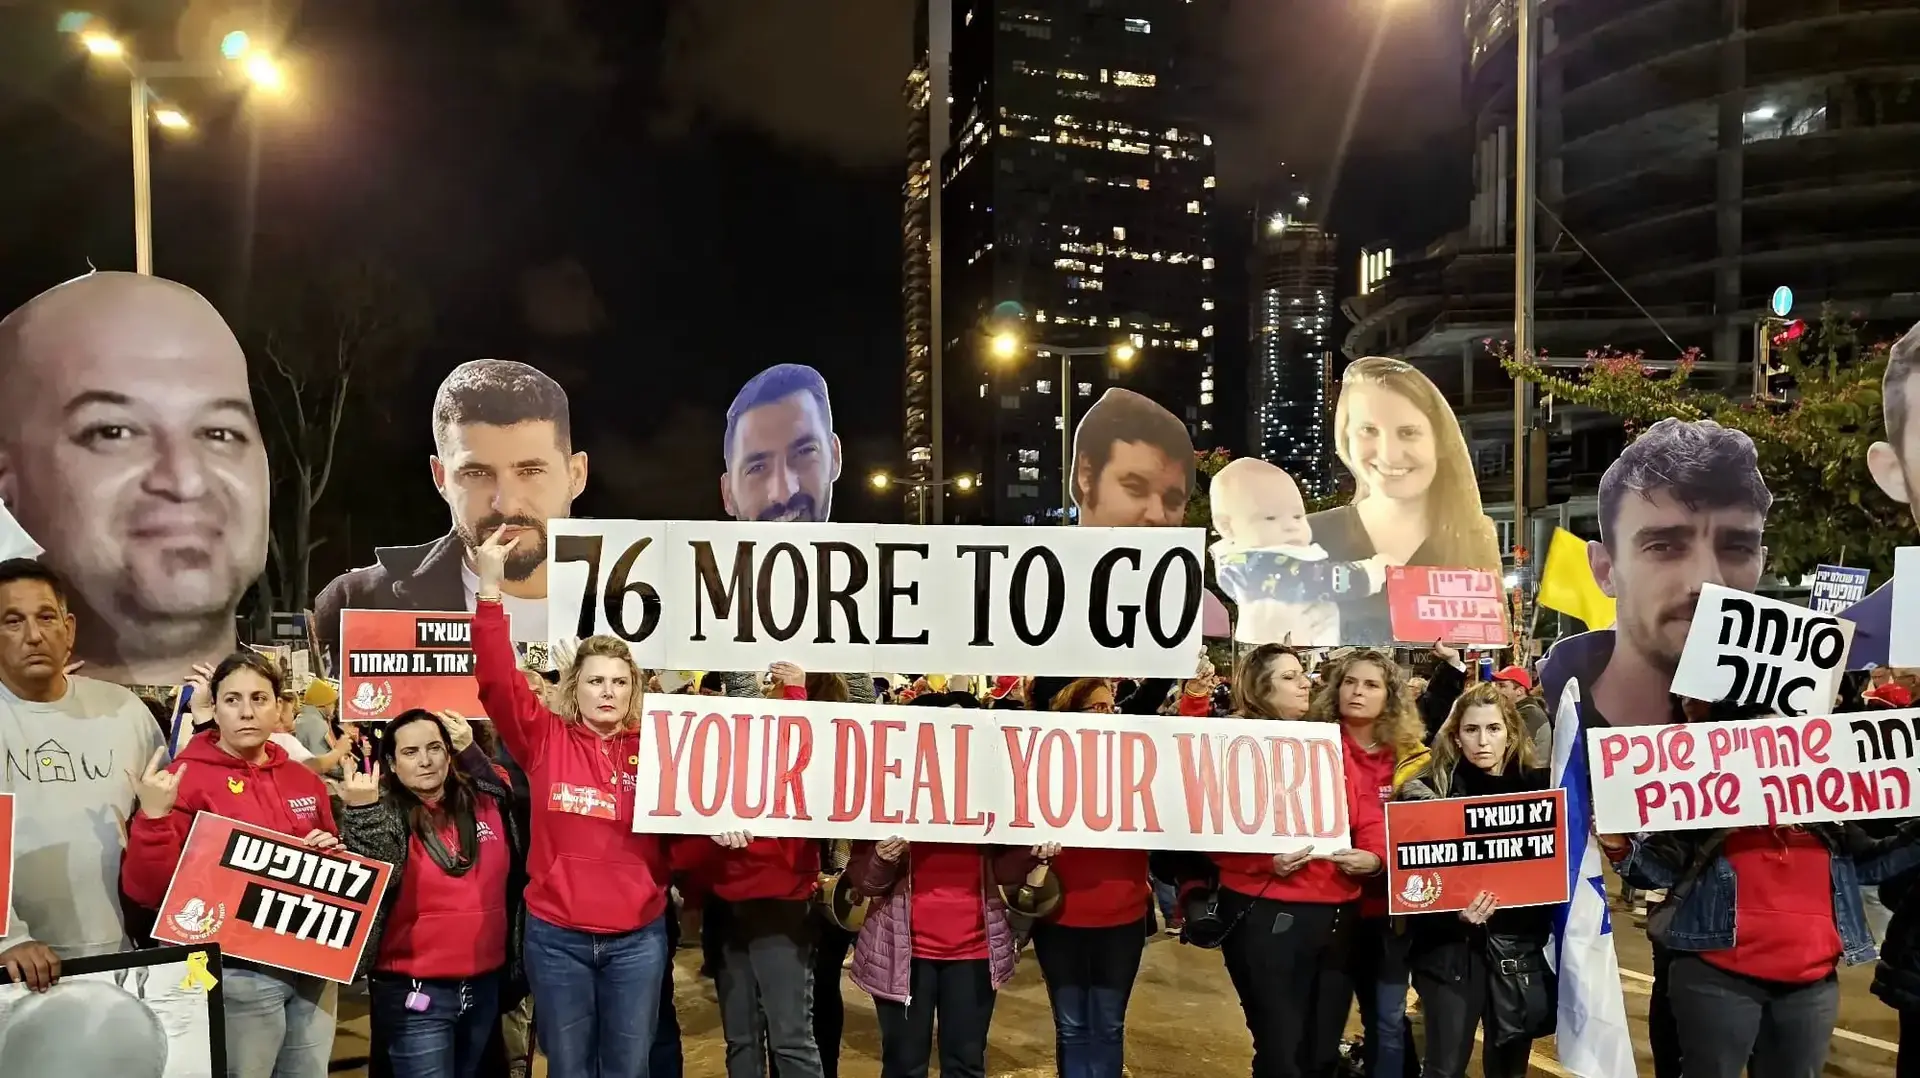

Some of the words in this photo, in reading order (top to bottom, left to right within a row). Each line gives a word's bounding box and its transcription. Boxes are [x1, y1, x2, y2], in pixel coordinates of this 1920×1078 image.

[555, 535, 661, 642] 76
[688, 541, 930, 647] MORE
[957, 545, 1066, 647] TO
[1088, 546, 1202, 649] GO
[1432, 572, 1493, 594] עדיין
[1814, 581, 1863, 601] חופשיים
[417, 621, 471, 642] נשאיר
[1718, 598, 1845, 669] סליחה
[349, 653, 408, 674] מאחור
[1600, 724, 1696, 779] שלכם
[1708, 718, 1832, 771] שהחיים
[647, 709, 812, 821] YOUR
[827, 718, 996, 836] DEAL,
[1000, 726, 1165, 833] YOUR
[1173, 732, 1346, 838] WORD
[1466, 804, 1524, 828] נשאיר
[1529, 799, 1553, 824] לא
[1635, 771, 1741, 828] שלהם
[1759, 767, 1911, 827] המשחק
[1397, 842, 1459, 866] מאחור
[1462, 837, 1524, 862] אחד.ת
[1527, 834, 1554, 857] אף
[229, 834, 372, 898] לחופש
[252, 888, 355, 950] נולדו
